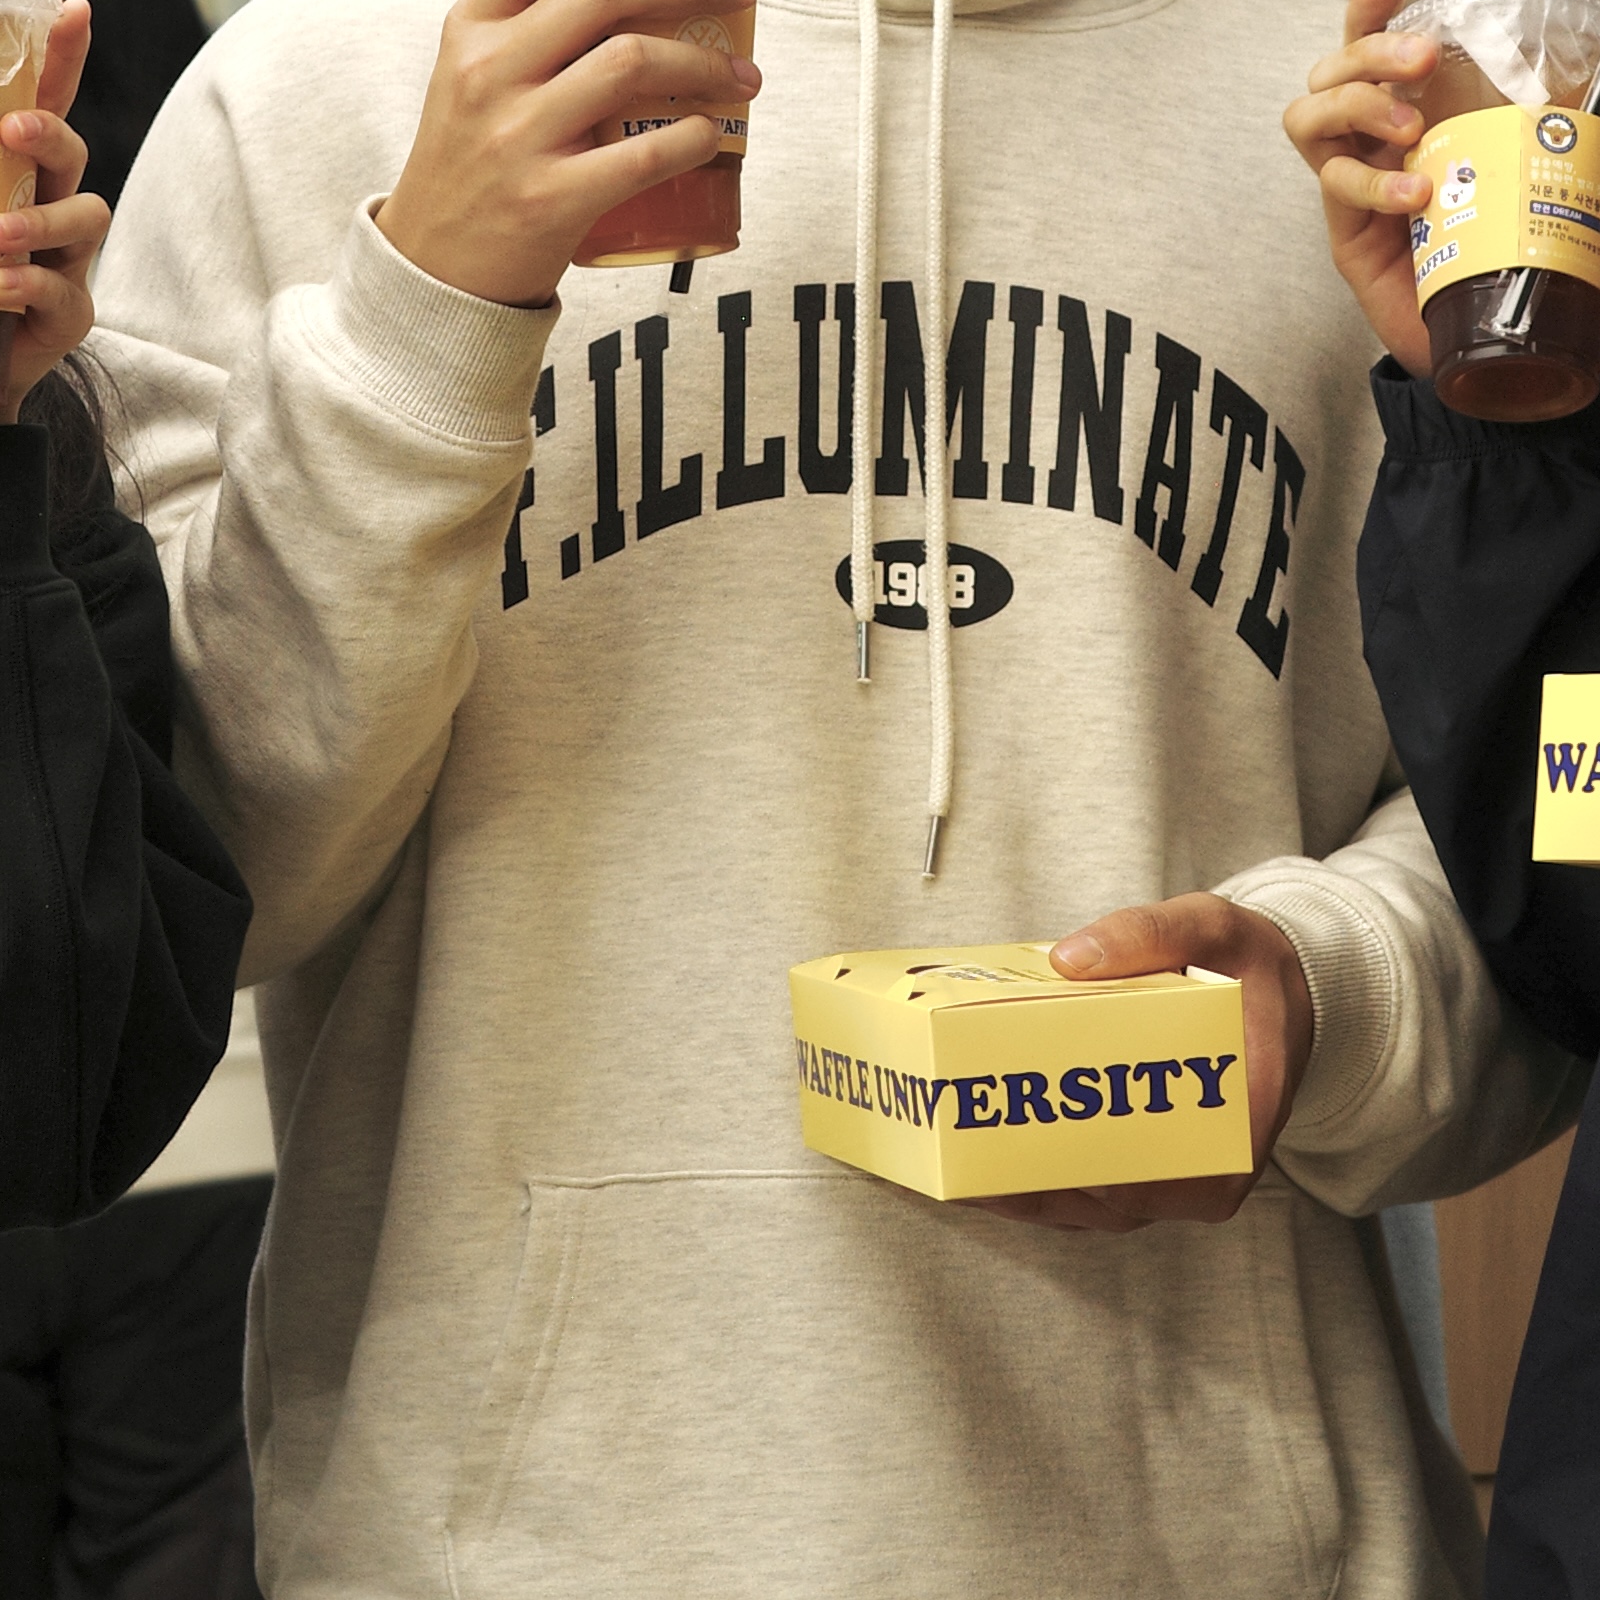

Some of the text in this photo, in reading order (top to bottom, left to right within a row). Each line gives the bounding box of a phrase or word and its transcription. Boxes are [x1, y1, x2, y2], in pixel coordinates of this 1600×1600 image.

[623, 117, 683, 137] LET'
[1529, 183, 1554, 199] 지문
[1552, 205, 1583, 221] DREAM
[795, 1036, 1238, 1132] WAFFLE UNIVERSITY
